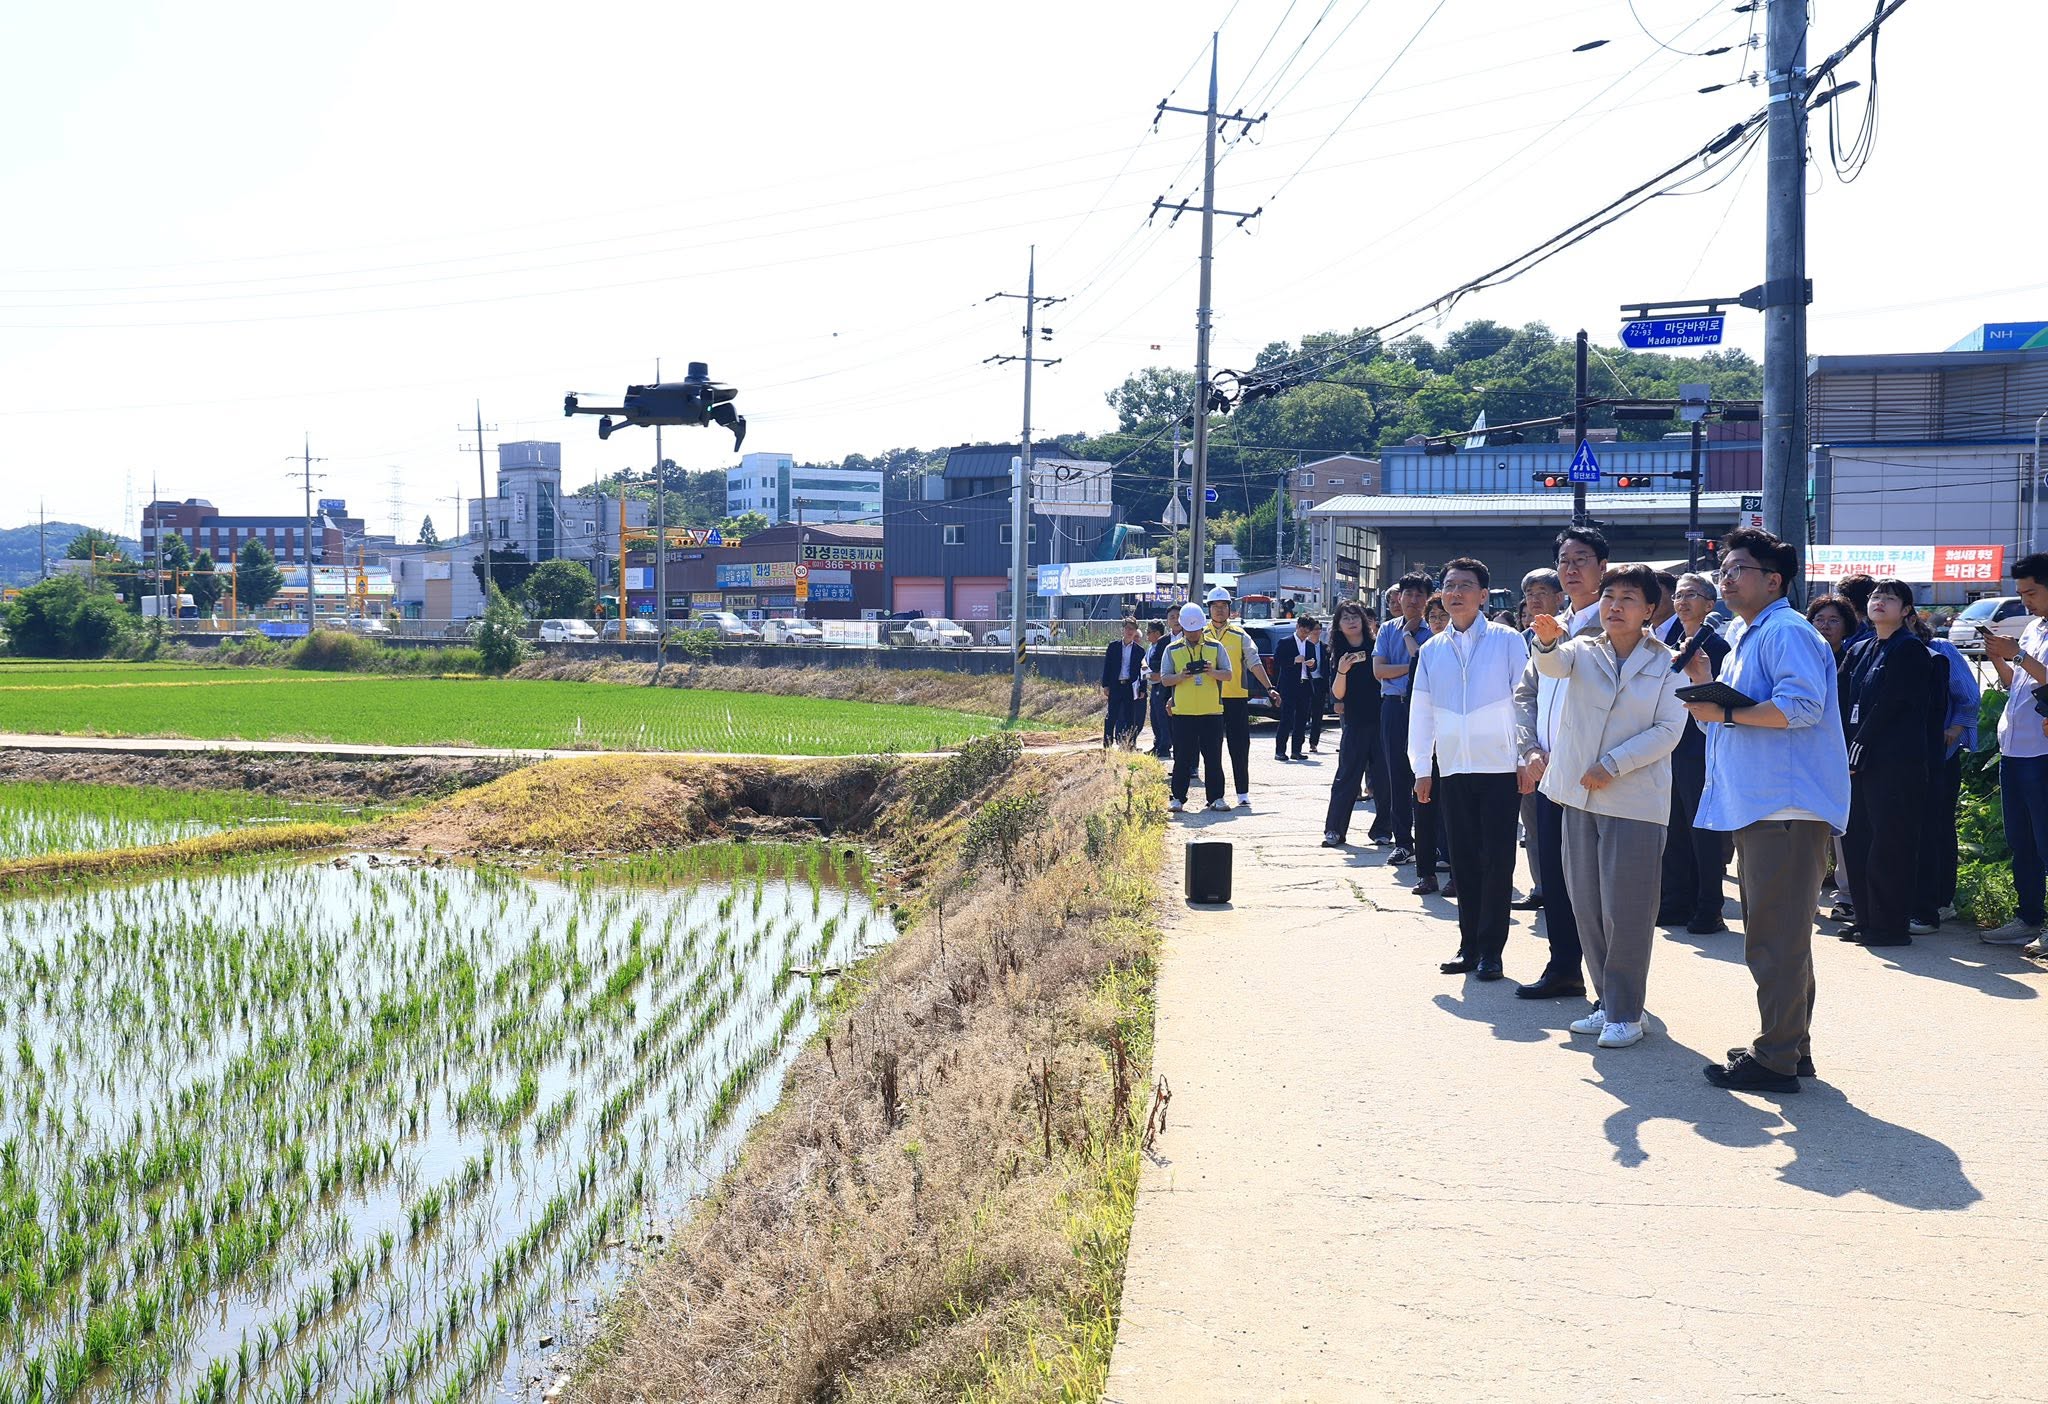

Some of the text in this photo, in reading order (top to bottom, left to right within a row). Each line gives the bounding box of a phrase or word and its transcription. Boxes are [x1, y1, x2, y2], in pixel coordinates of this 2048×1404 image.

[1630, 329, 1651, 337] 72-93
[1665, 320, 1720, 334] 마당바위로
[1647, 334, 1718, 346] Madangbawi-ro
[1990, 330, 2013, 339] NH
[1818, 550, 1843, 563] 믿고
[1845, 550, 1884, 562] 지지해
[1888, 550, 1926, 562] 주셔서
[1945, 549, 1993, 561] 화성시장 후보
[825, 560, 876, 570] 366-3116
[1830, 563, 1896, 576] 감사합니다!
[1944, 563, 1992, 579] 박태경
